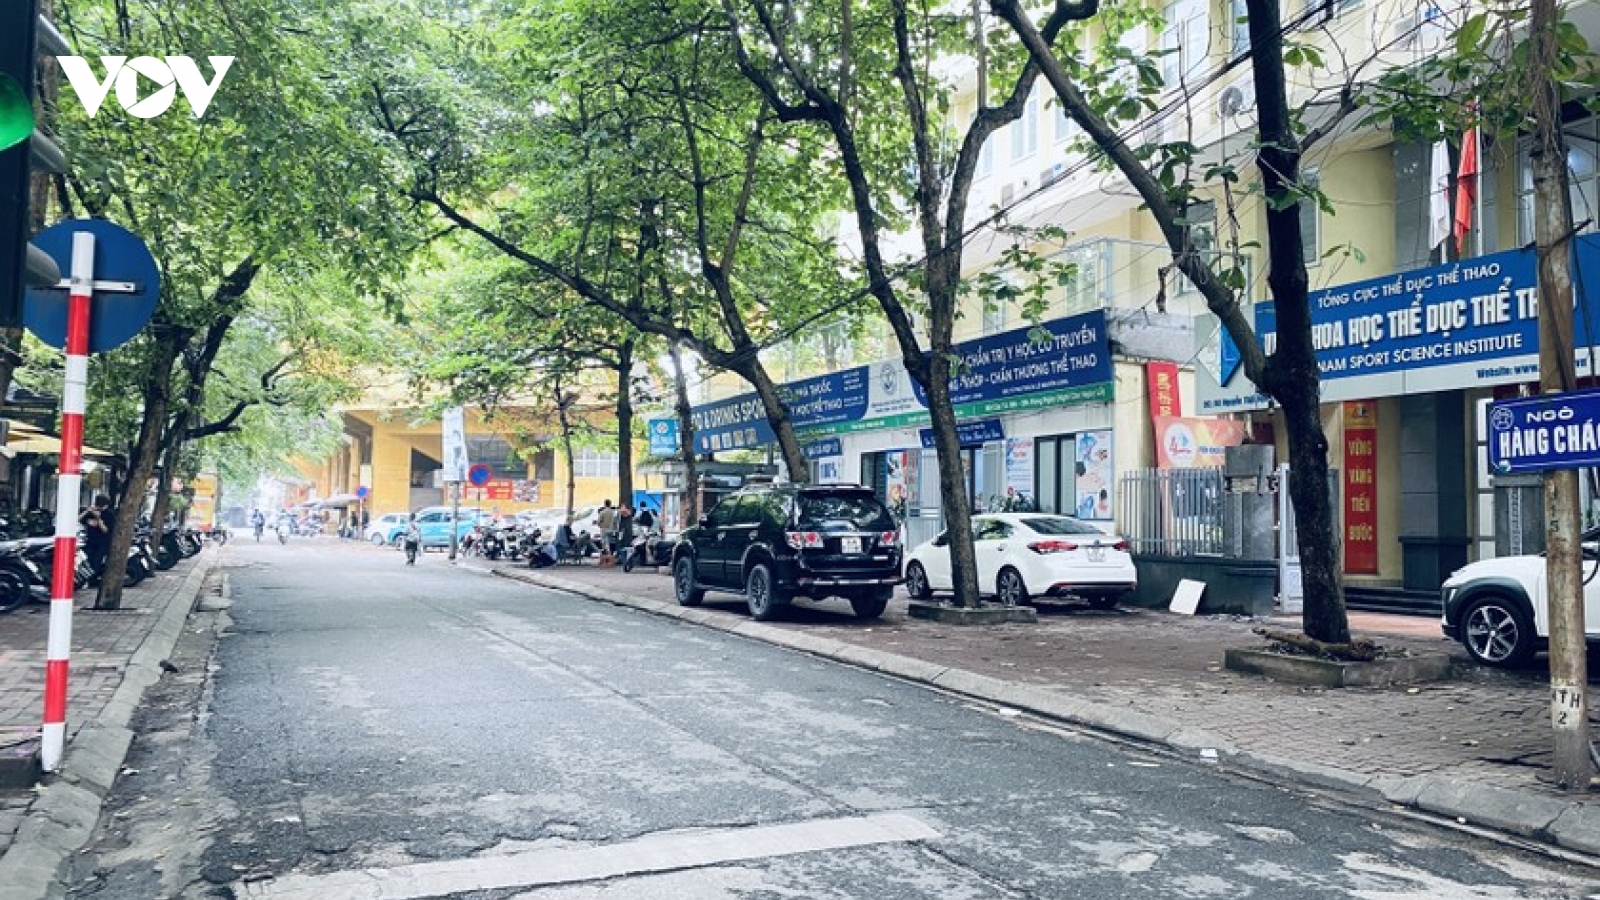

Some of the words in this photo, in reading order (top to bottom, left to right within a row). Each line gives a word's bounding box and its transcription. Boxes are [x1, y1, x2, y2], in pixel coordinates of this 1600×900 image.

[1318, 289, 1350, 308] TỔNG
[1354, 286, 1379, 303] CỤC
[1382, 275, 1403, 297] THỂ
[1406, 276, 1432, 294] DỤC
[1437, 265, 1459, 286] THỂ
[1463, 262, 1500, 282] THAO
[1312, 322, 1344, 351] HOA
[1349, 314, 1384, 349] HỌC
[1387, 293, 1424, 340] THỂ
[1427, 302, 1467, 338] DỤC
[1471, 276, 1513, 325] THỂ
[1070, 352, 1097, 371] THAO
[1350, 352, 1390, 369] SPORT
[1394, 343, 1452, 363] SCIENCE
[1454, 333, 1522, 356] INSTITUTE
[1499, 426, 1550, 459] HÀNG
[1553, 418, 1600, 454] CHÁ
[1351, 491, 1371, 512] TIẾN
[1558, 710, 1569, 725] 2
